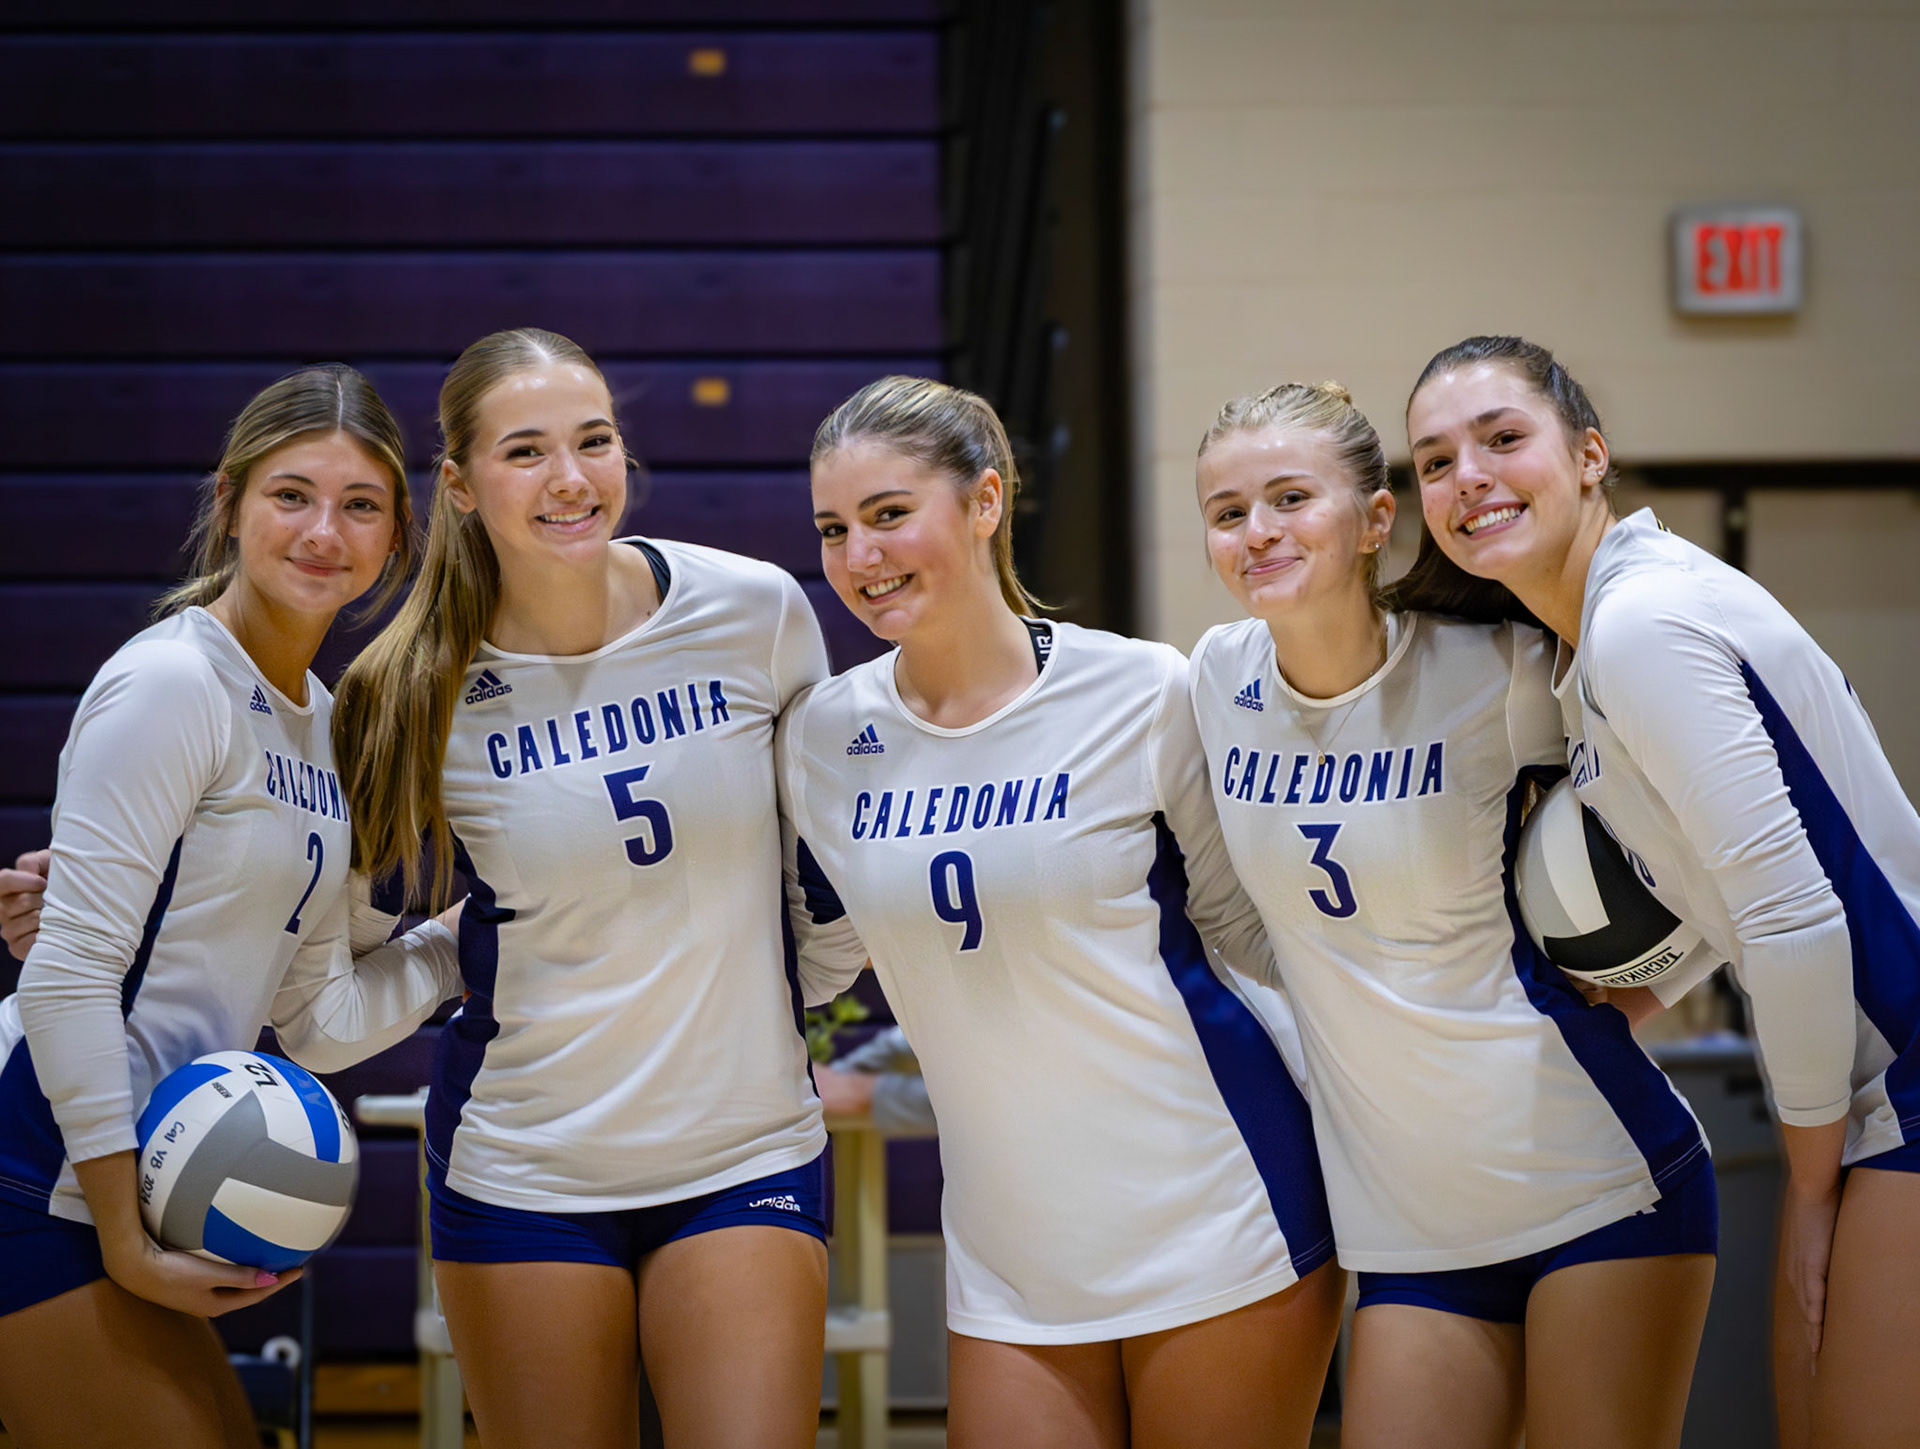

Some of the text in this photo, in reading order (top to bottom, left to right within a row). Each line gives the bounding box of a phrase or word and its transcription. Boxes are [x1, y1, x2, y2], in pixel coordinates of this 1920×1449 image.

[1694, 224, 1784, 297] EXIT
[465, 683, 513, 704] adidas
[486, 679, 731, 779] CALEDONIA
[1234, 695, 1264, 712] adidas
[265, 750, 348, 822] CALEDONI
[851, 772, 1070, 840] CALEDONIA
[1223, 741, 1444, 804] CALEDONIA
[602, 764, 674, 866] 5
[284, 831, 324, 934] 2
[929, 850, 983, 952] 9
[1296, 823, 1358, 918] 3
[1601, 951, 1684, 984] TACHIKARA
[140, 1120, 186, 1206] Cal VB 2024
